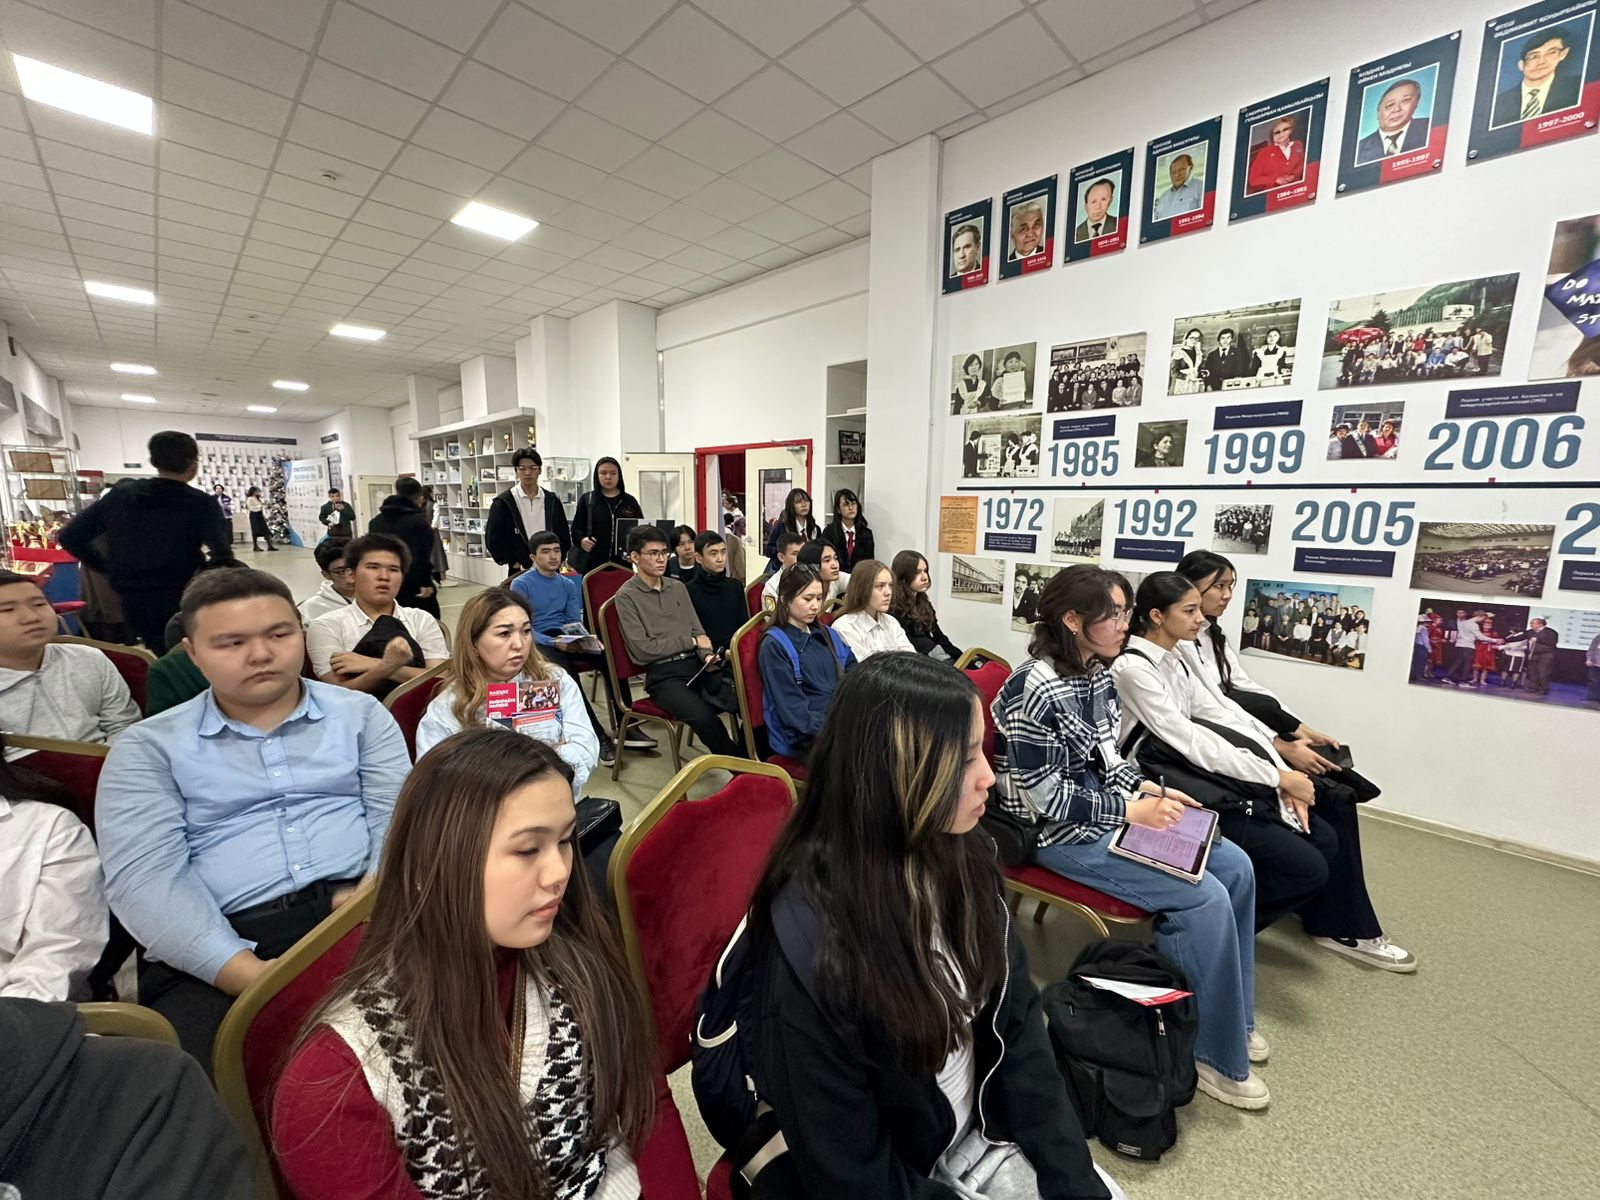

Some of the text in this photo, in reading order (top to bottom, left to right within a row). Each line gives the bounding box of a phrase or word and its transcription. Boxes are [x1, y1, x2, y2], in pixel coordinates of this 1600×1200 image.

[1537, 112, 1585, 130] 1997-2000
[1561, 278, 1589, 291] DO
[1048, 439, 1119, 477] 1985
[1204, 429, 1305, 475] 1999
[1424, 415, 1585, 471] 2006
[983, 498, 1044, 531] 1972
[1114, 498, 1197, 538] 1992
[1291, 500, 1416, 547] 2005
